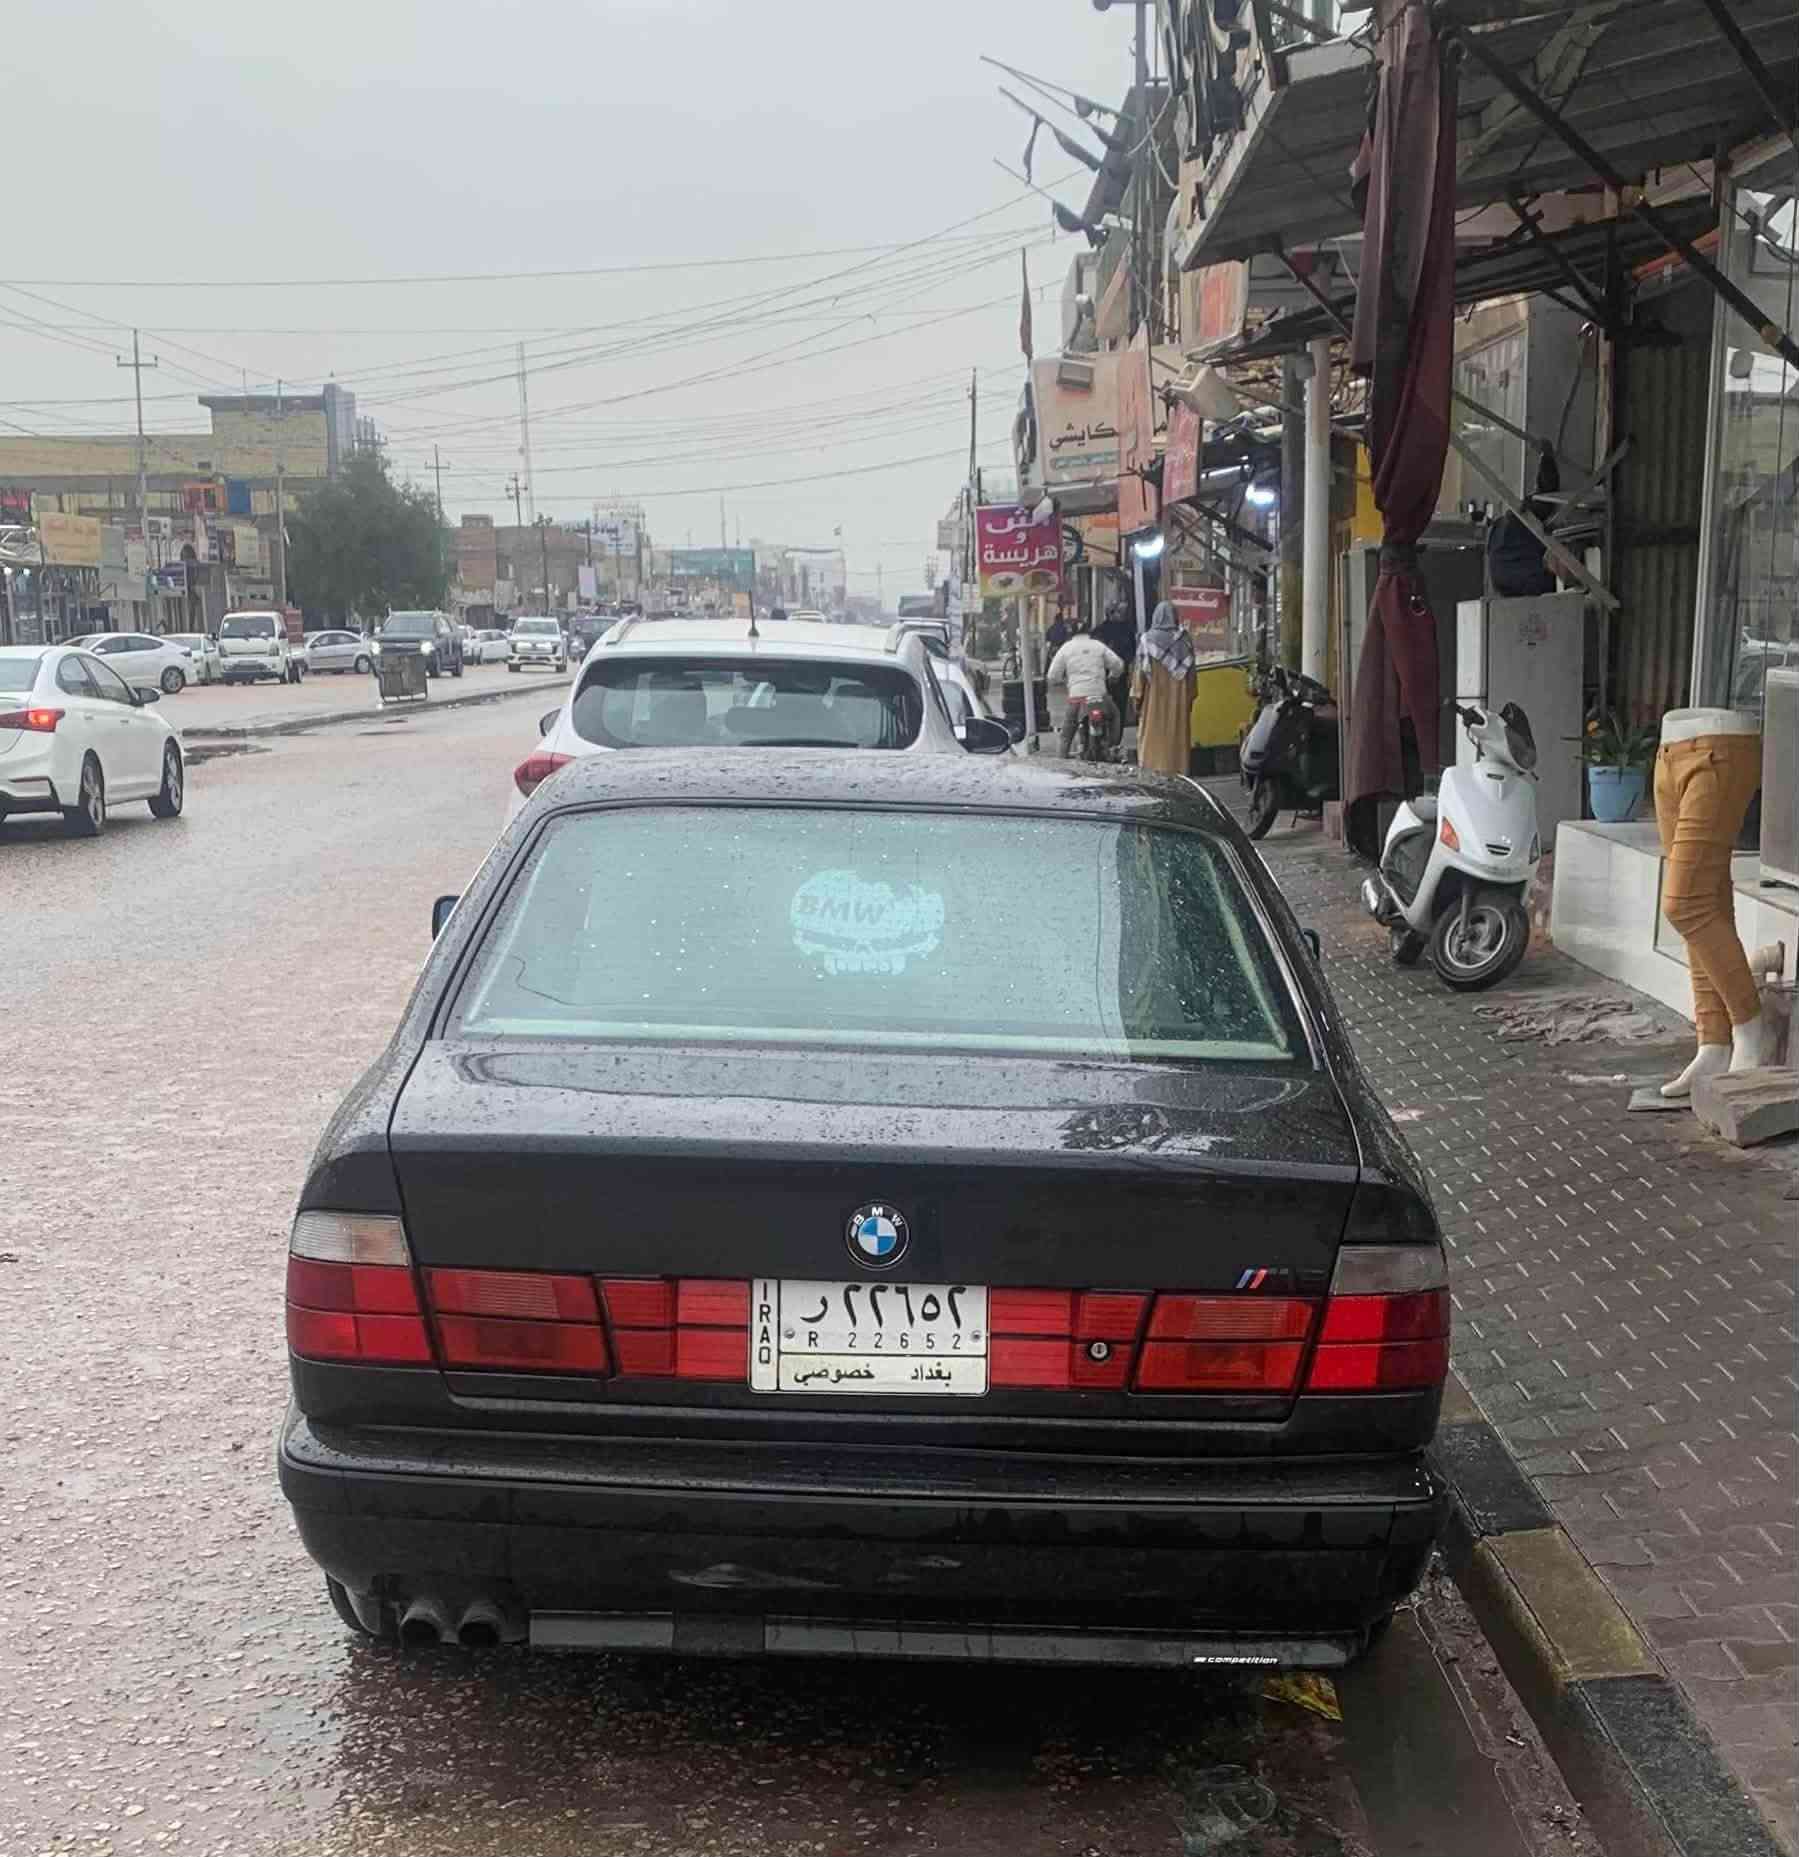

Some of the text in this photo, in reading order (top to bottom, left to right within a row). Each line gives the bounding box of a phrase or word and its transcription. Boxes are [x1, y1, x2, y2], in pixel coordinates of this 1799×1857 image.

[1016, 531, 1027, 544] و
[983, 544, 1058, 568] هريسة
[853, 1206, 904, 1227] BMW
[758, 1281, 771, 1365] IRAQ
[794, 1361, 952, 1388] بغداد خصوصي
